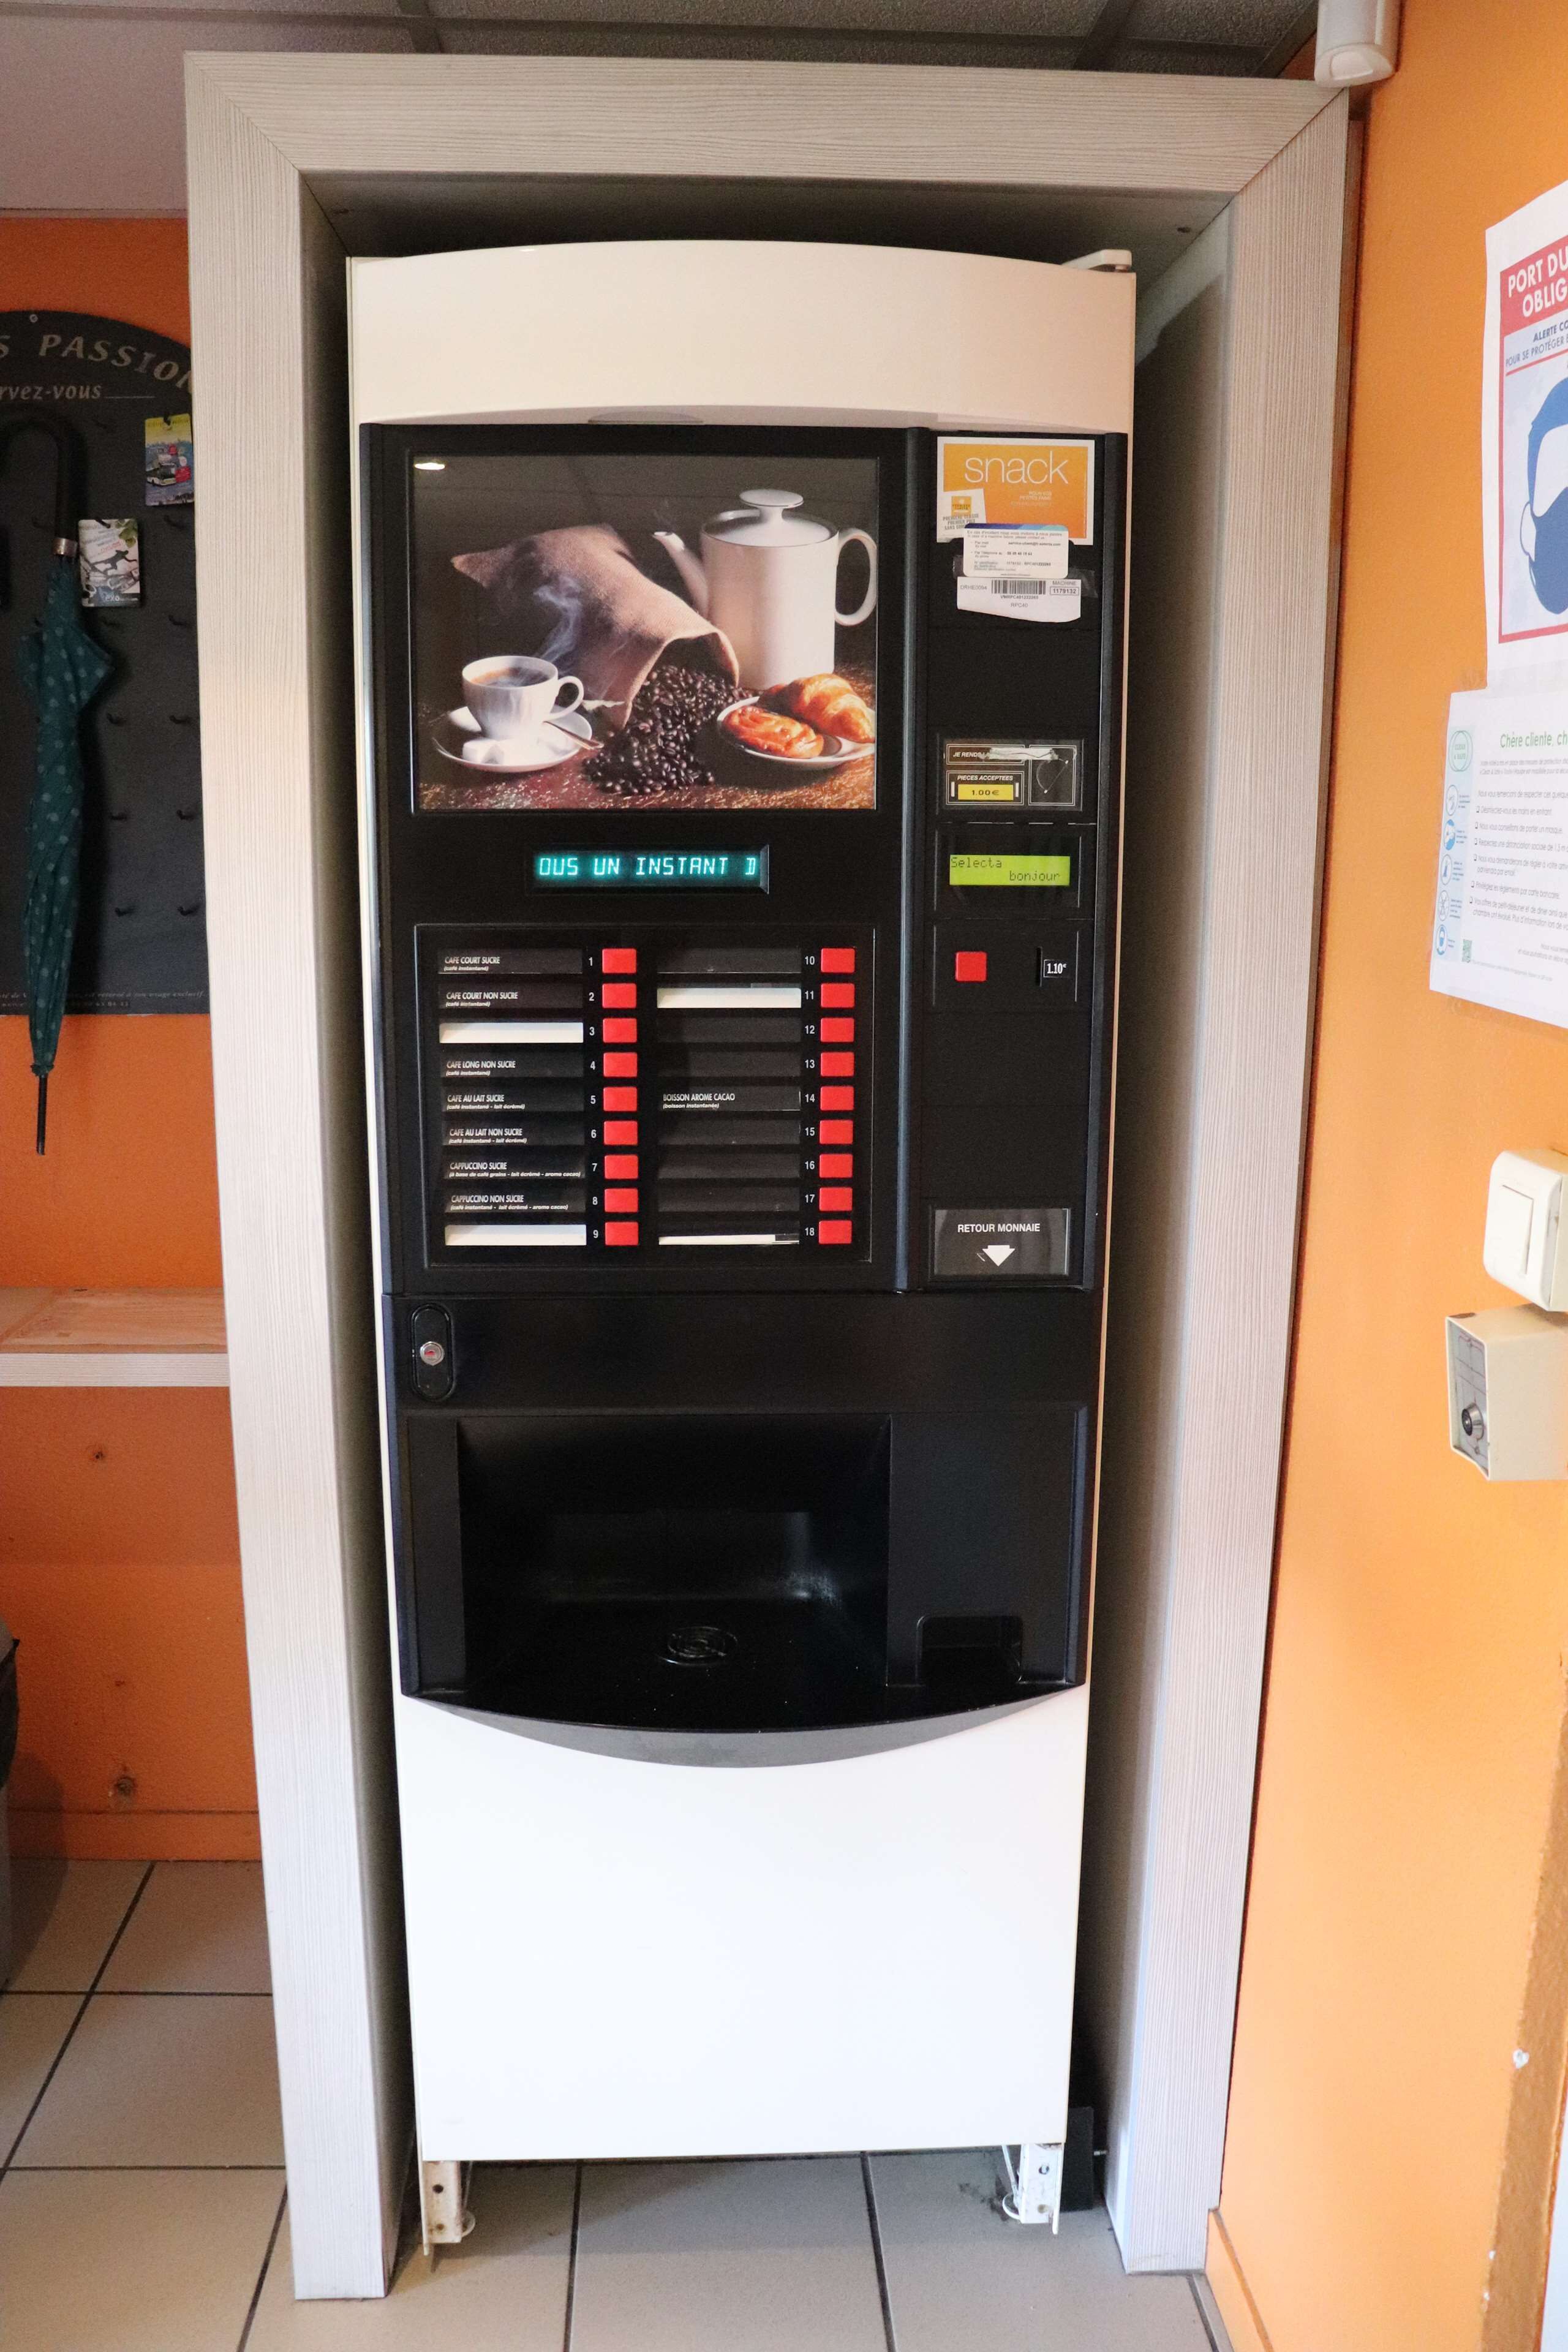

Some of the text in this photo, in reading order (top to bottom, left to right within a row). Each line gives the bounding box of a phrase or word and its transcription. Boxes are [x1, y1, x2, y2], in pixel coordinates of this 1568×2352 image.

[1509, 246, 1568, 298] PORT DU
[1523, 278, 1567, 317] OBLIG
[1533, 324, 1557, 342] ALERTE
[1506, 353, 1520, 367] POUR
[1523, 349, 1529, 360] SE
[1531, 336, 1564, 358] PROTÉGER
[965, 451, 1069, 484] snack
[1500, 731, 1523, 748] Chère
[539, 858, 756, 876] OUS UN INSTANT D
[951, 858, 1002, 868] Selecta
[1009, 870, 1060, 881] bonjour
[588, 957, 593, 966] 1
[804, 956, 815, 965] 10
[589, 992, 595, 1001] 2
[804, 990, 815, 1000] 11
[589, 1027, 595, 1036] 3
[804, 1025, 815, 1035] 12
[447, 1060, 461, 1069] CAFE
[462, 1060, 480, 1069] LONG
[481, 1060, 497, 1069] NON
[590, 1061, 596, 1070] 4
[804, 1059, 815, 1069] 13
[590, 1095, 596, 1105] 5
[805, 1093, 815, 1103] 14
[590, 1129, 597, 1139] 6
[805, 1127, 815, 1136] 15
[592, 1163, 598, 1172] 7
[805, 1161, 815, 1170] 16
[592, 1196, 598, 1205] 8
[805, 1194, 815, 1204] 17
[805, 1227, 815, 1237] 18
[957, 1223, 1041, 1233] RETOUR MONNAIE
[592, 1229, 599, 1238] 9
